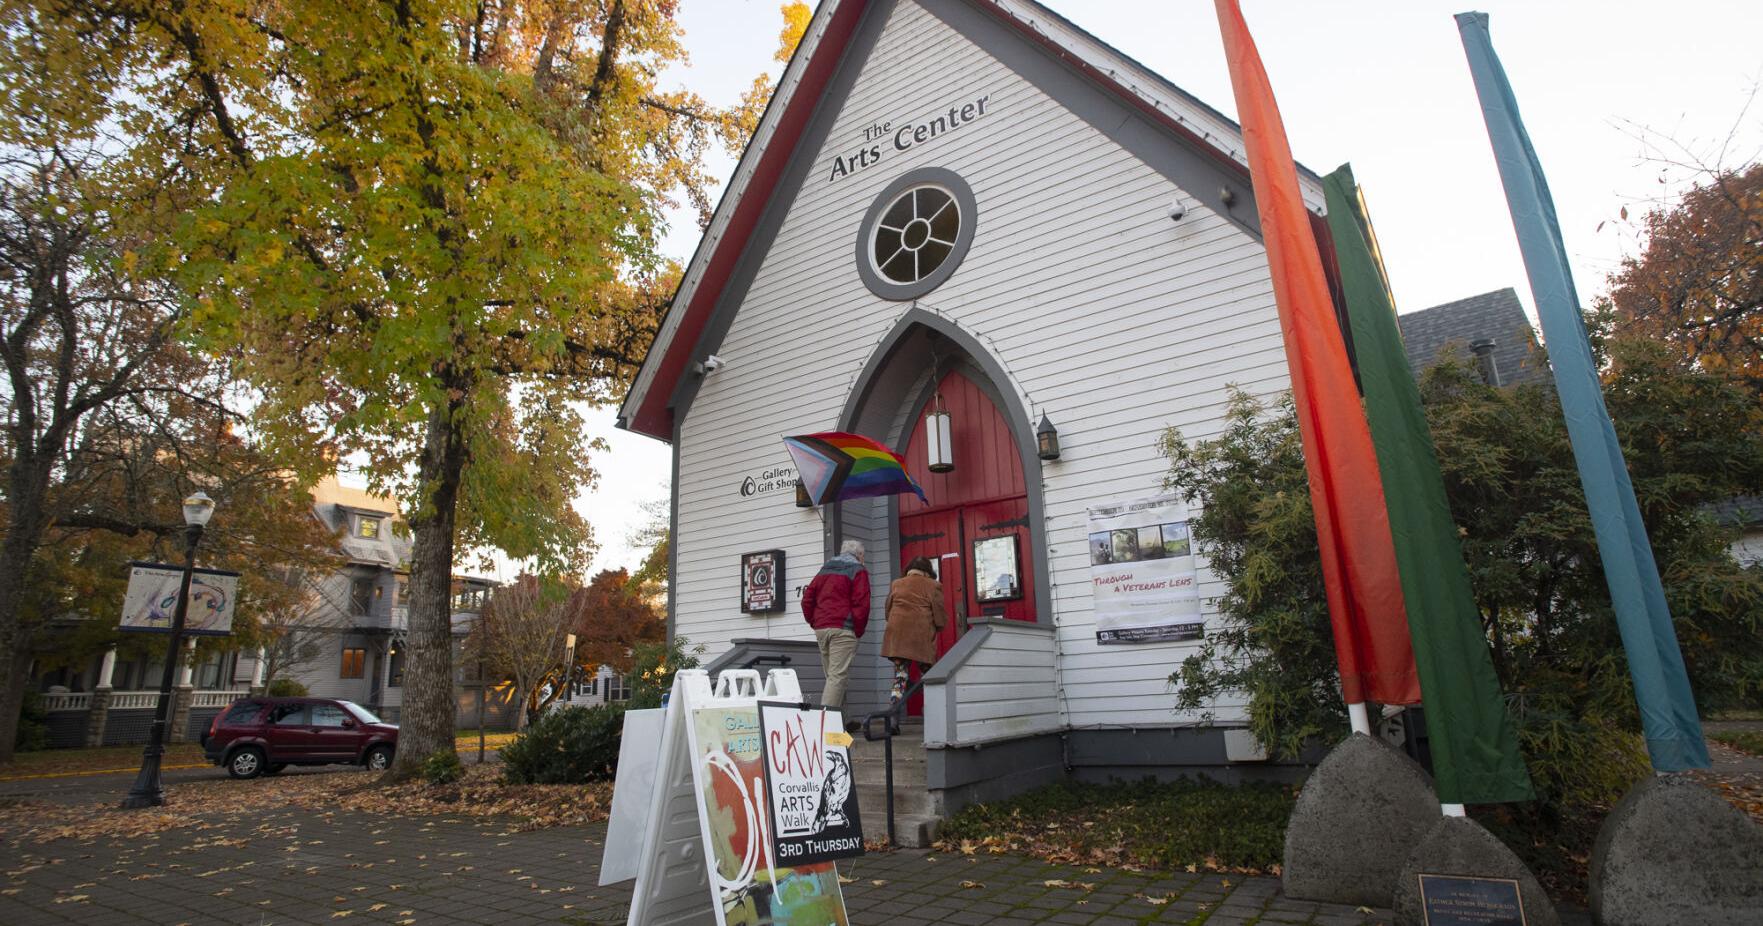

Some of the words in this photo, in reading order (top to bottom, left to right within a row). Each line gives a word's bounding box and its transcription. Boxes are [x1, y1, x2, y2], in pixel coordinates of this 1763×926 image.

[829, 145, 880, 182] Arts
[894, 95, 989, 151] Center
[863, 121, 891, 141] The
[762, 468, 793, 480] Gallery
[757, 481, 774, 493] Gift
[1094, 573, 1133, 586] THROUGH
[1169, 578, 1192, 587] LENS
[771, 709, 825, 779] CAW
[779, 781, 820, 794] Corvallis
[781, 795, 814, 813] ARTS
[781, 813, 810, 828] Walk
[779, 843, 803, 857] 3RD
[805, 837, 861, 854] THURSDAY
